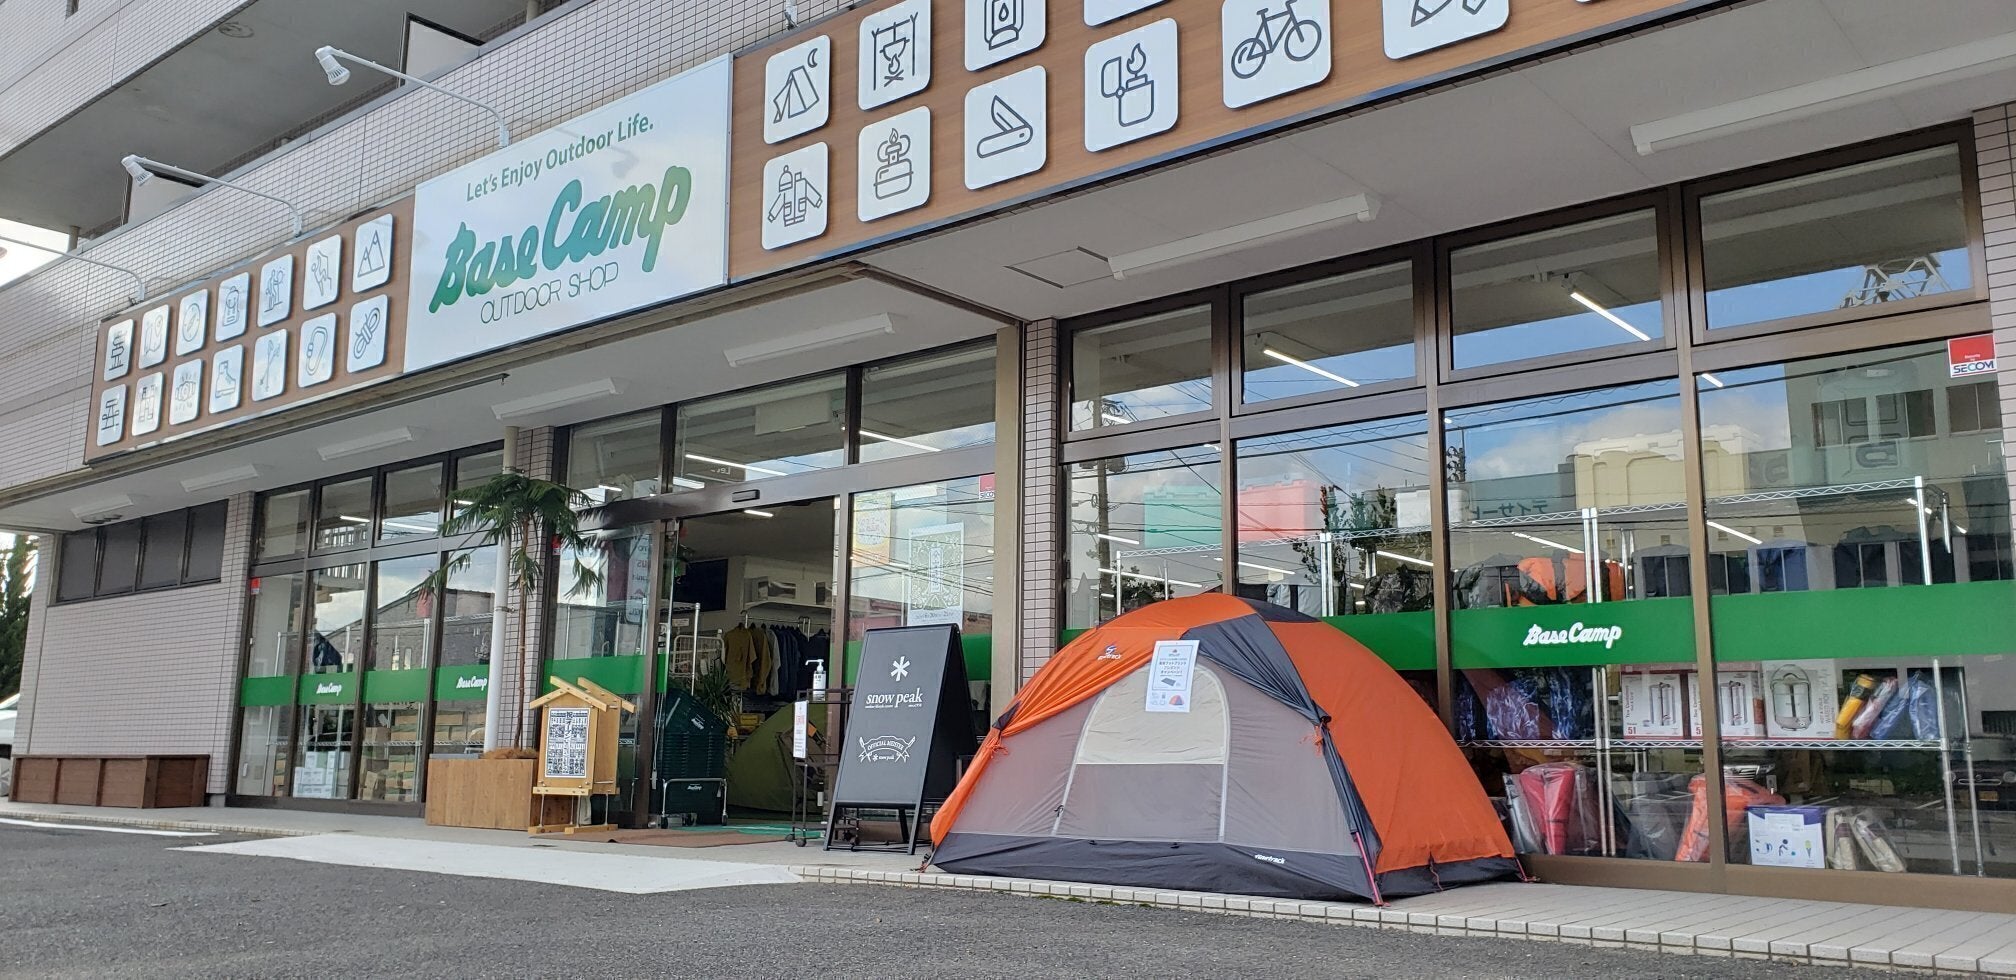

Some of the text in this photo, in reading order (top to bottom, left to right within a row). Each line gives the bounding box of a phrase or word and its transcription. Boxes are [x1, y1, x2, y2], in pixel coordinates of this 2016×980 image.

[467, 112, 654, 202] Let's Enjoy Outdoor Life.
[480, 262, 619, 324] OUTDOOR SHOP
[1953, 361, 1995, 374] SECOM
[865, 687, 923, 708] snow peak
